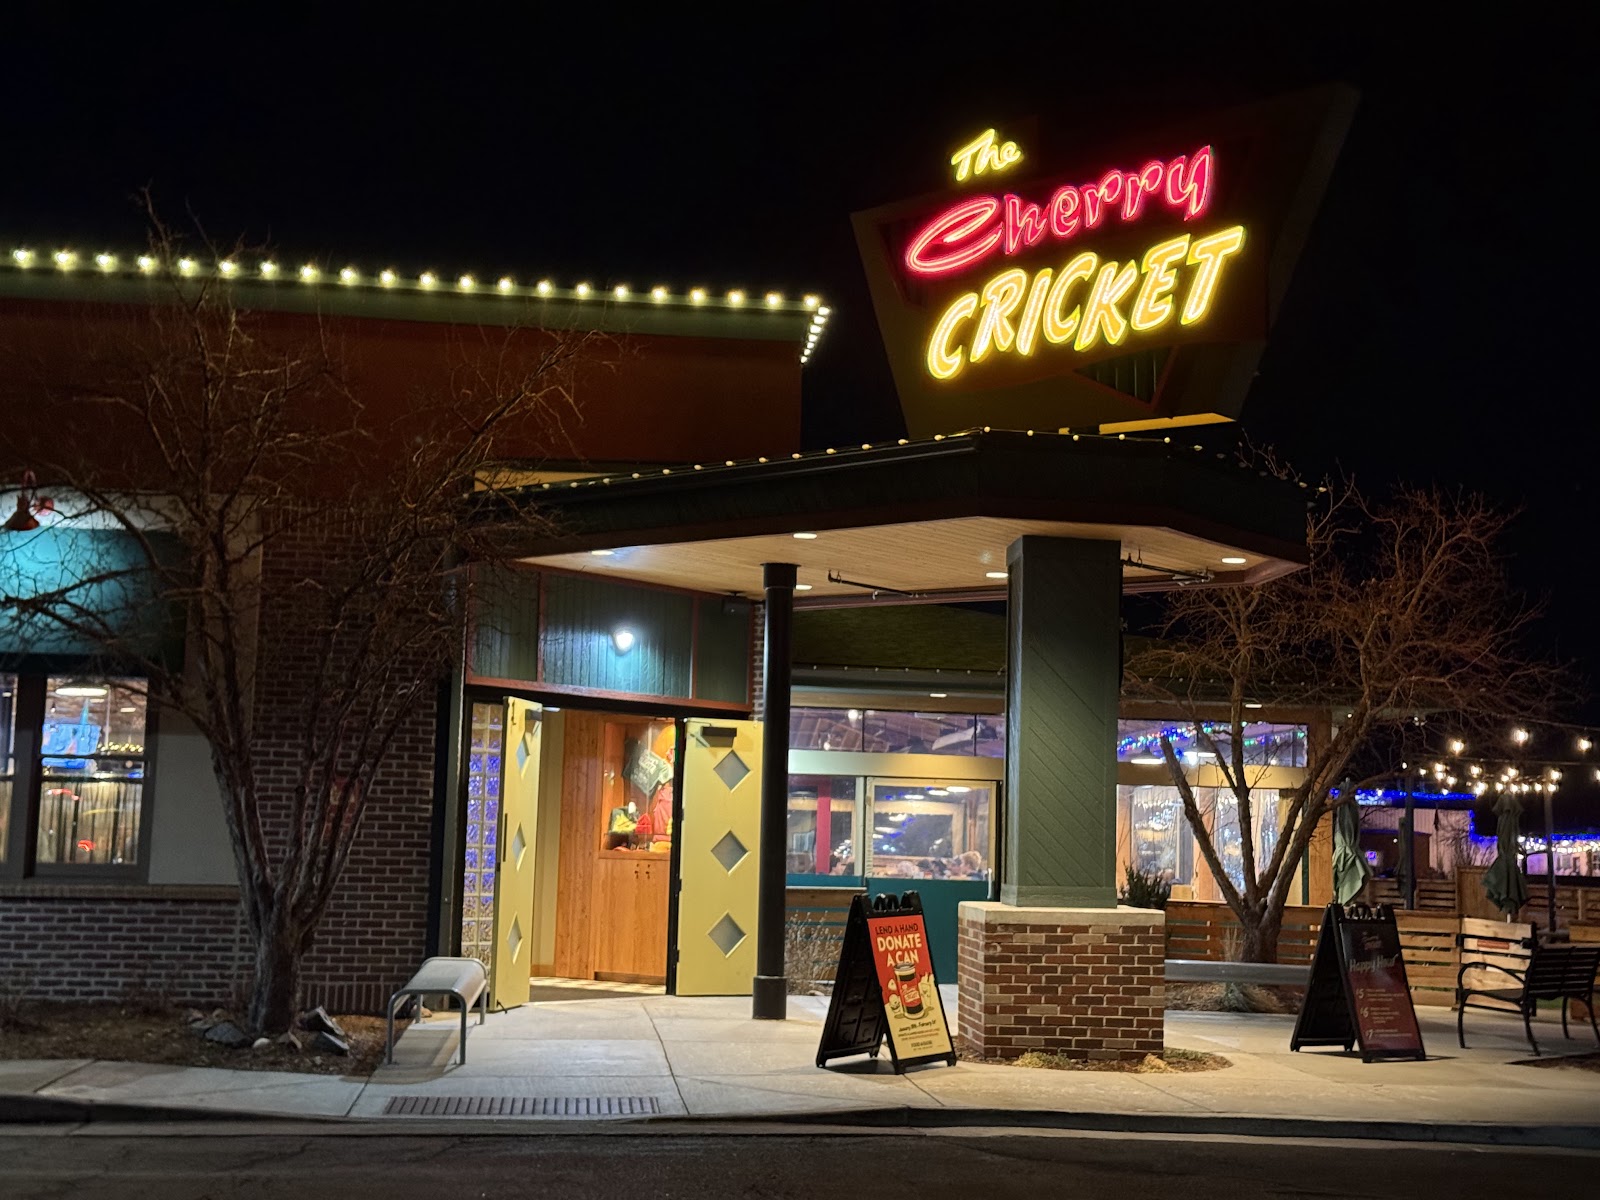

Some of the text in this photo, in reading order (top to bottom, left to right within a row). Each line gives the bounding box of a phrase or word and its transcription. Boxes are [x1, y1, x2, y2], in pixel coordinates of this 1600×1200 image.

[951, 128, 1022, 181] The
[906, 144, 1213, 272] Cherry
[928, 225, 1244, 379] CRICKET
[875, 925, 893, 935] LEND
[900, 923, 919, 933] HAND
[877, 933, 922, 952] DONATE
[887, 949, 919, 967] A CAN
[1350, 953, 1399, 974] Happy Hour
